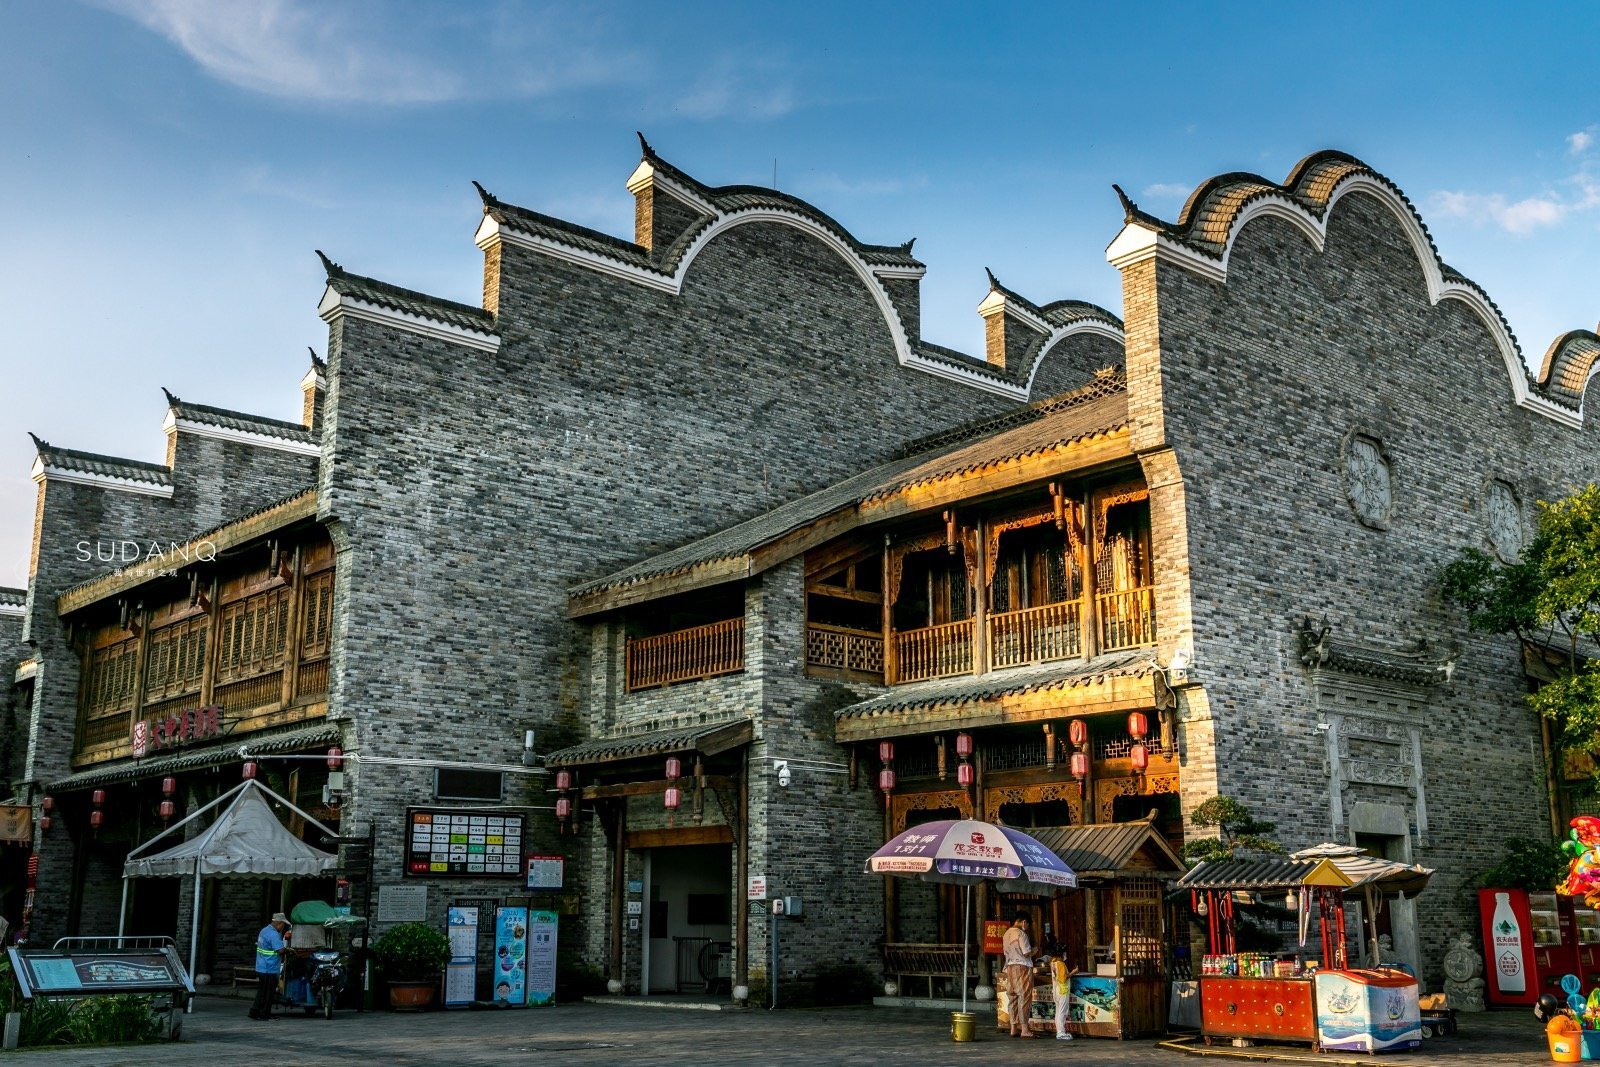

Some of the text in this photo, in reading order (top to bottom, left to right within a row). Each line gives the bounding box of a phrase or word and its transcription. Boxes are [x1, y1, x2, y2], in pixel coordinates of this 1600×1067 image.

[904, 834, 938, 844] 教师
[894, 845, 927, 854] 1对1
[954, 843, 1003, 855] 龙文教育
[1025, 854, 1054, 866] 1对1
